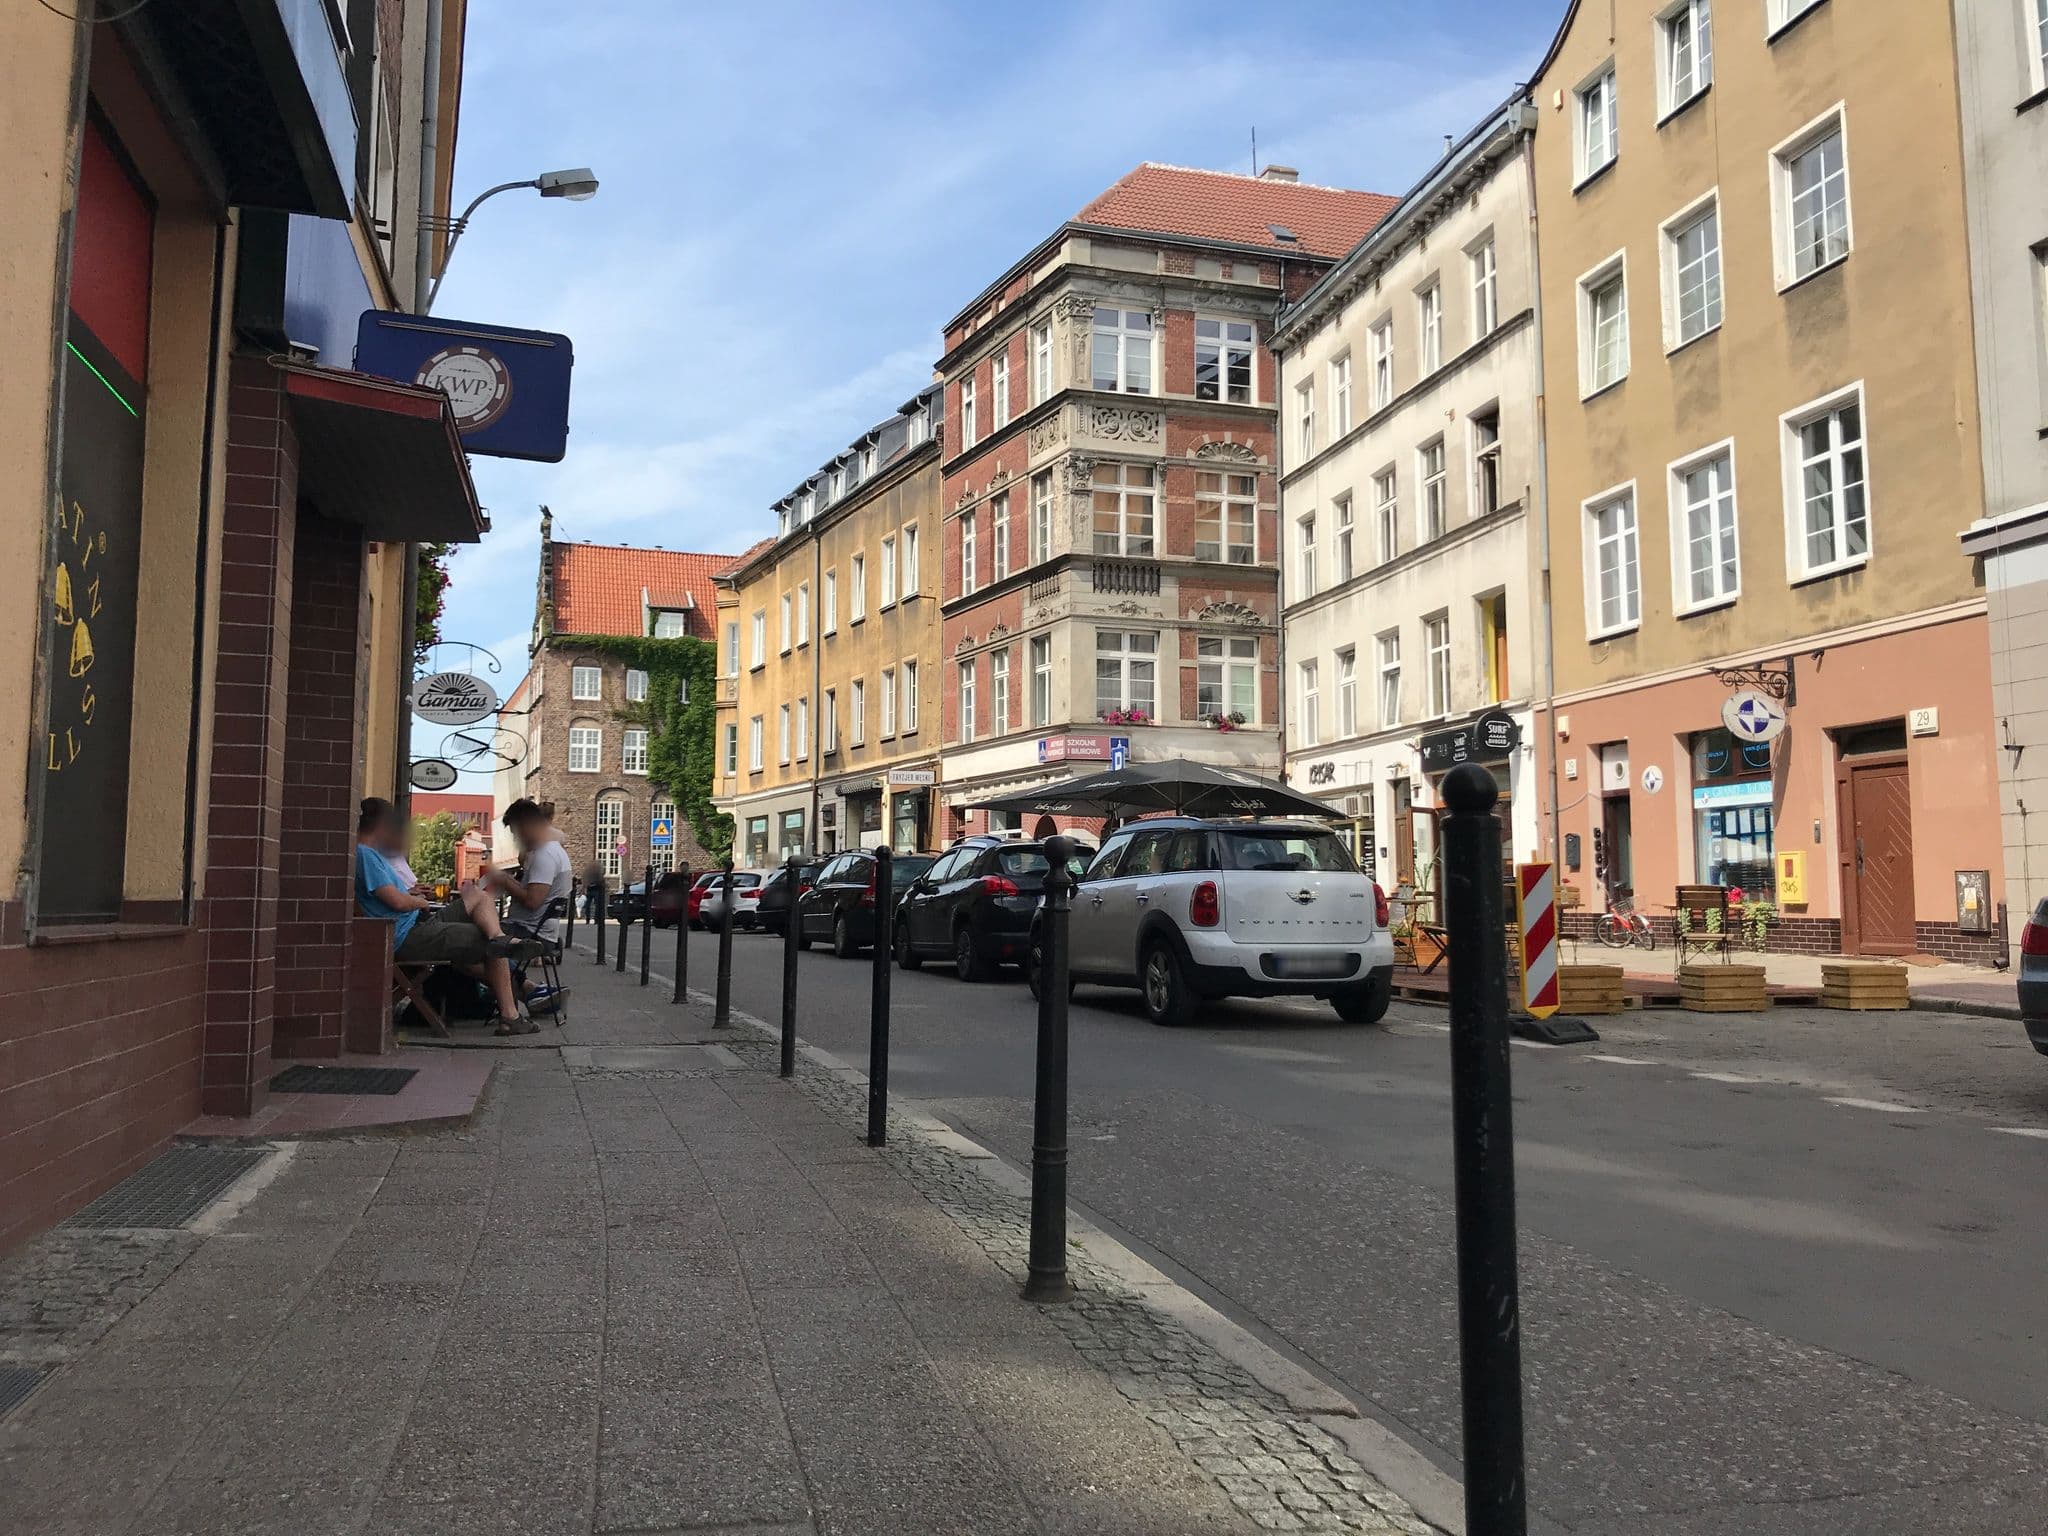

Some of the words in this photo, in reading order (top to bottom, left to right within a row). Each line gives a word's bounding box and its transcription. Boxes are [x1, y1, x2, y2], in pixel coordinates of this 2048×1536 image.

[434, 374, 488, 396] KWP
[418, 691, 488, 708] Gambas
[1917, 711, 1930, 727] 29
[1487, 724, 1508, 735] SURF
[1067, 739, 1097, 747] SZKOLNE
